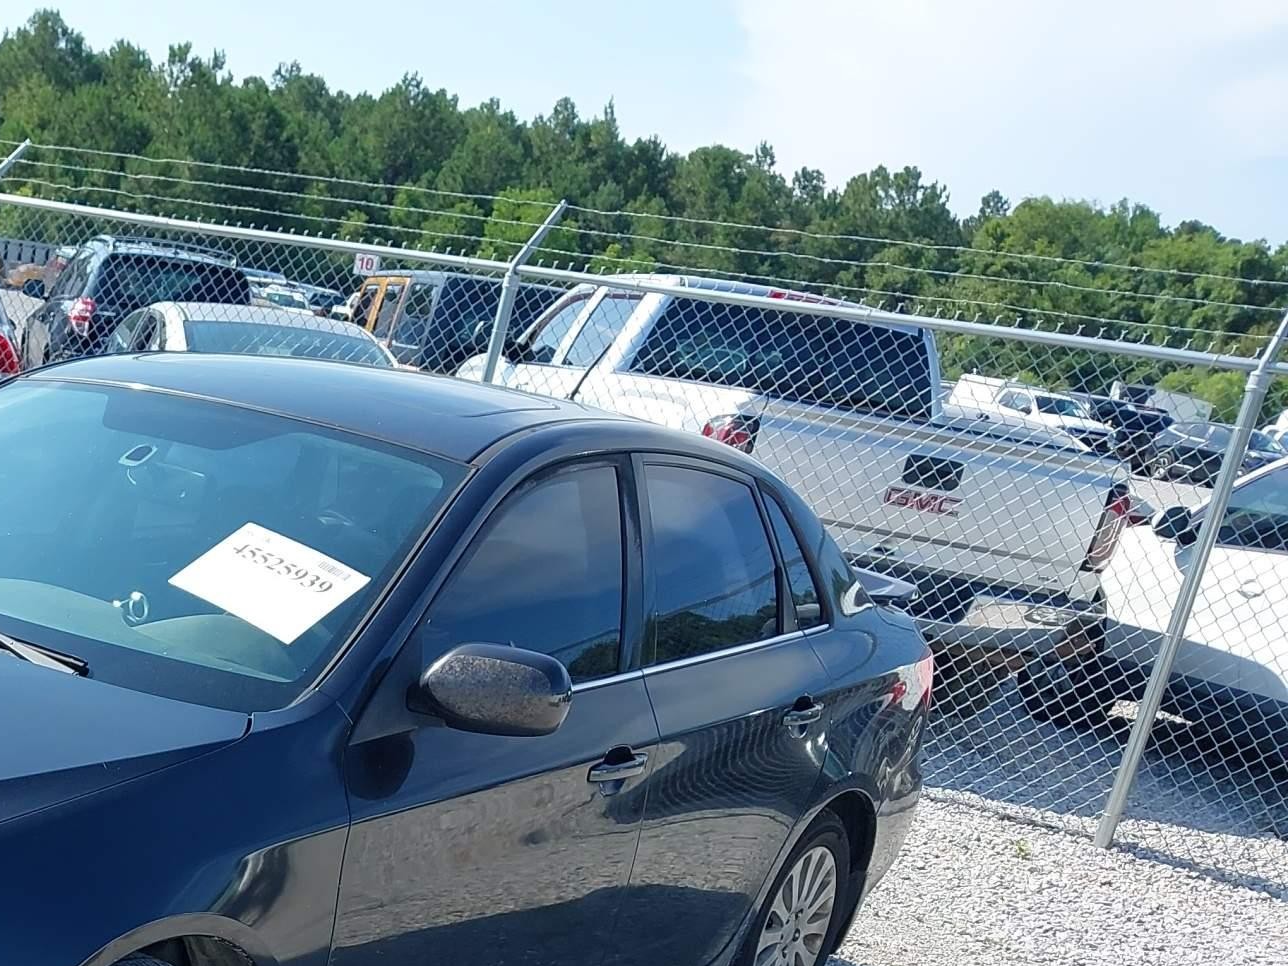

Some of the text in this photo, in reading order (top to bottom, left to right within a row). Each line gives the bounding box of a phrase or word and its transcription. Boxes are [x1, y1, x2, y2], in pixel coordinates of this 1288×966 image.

[359, 257, 374, 271] 10
[884, 486, 964, 516] GMC
[233, 543, 333, 593] 45525939
